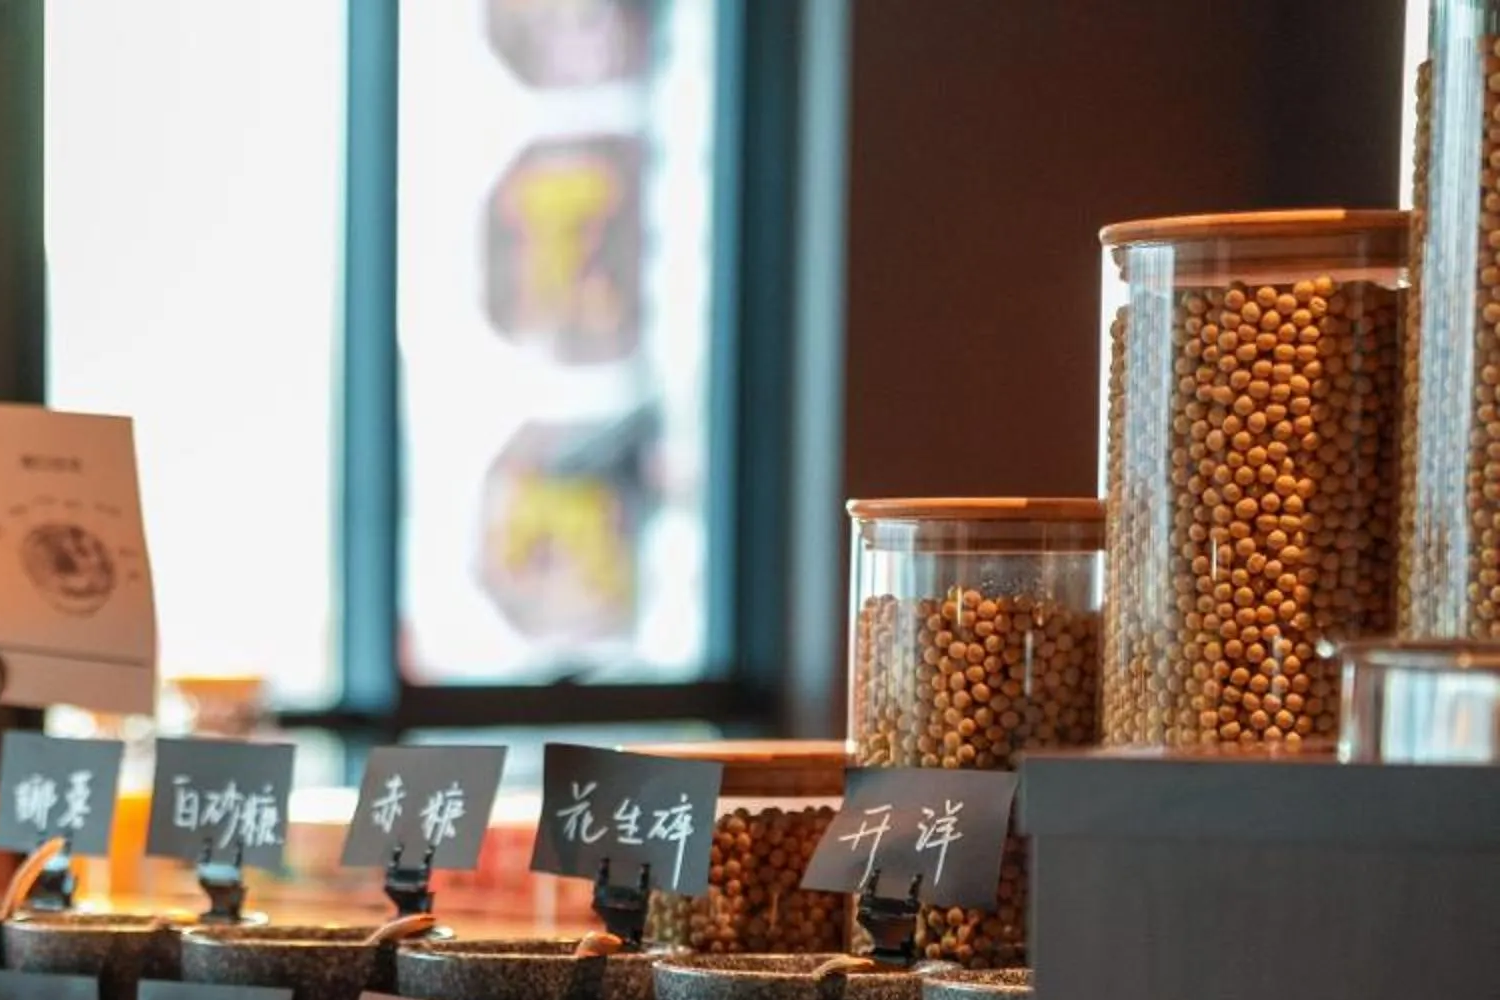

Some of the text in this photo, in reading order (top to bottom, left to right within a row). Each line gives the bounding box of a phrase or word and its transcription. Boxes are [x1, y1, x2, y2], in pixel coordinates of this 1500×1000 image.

[556, 781, 695, 890] 花生碎
[838, 799, 965, 889] 开洋
